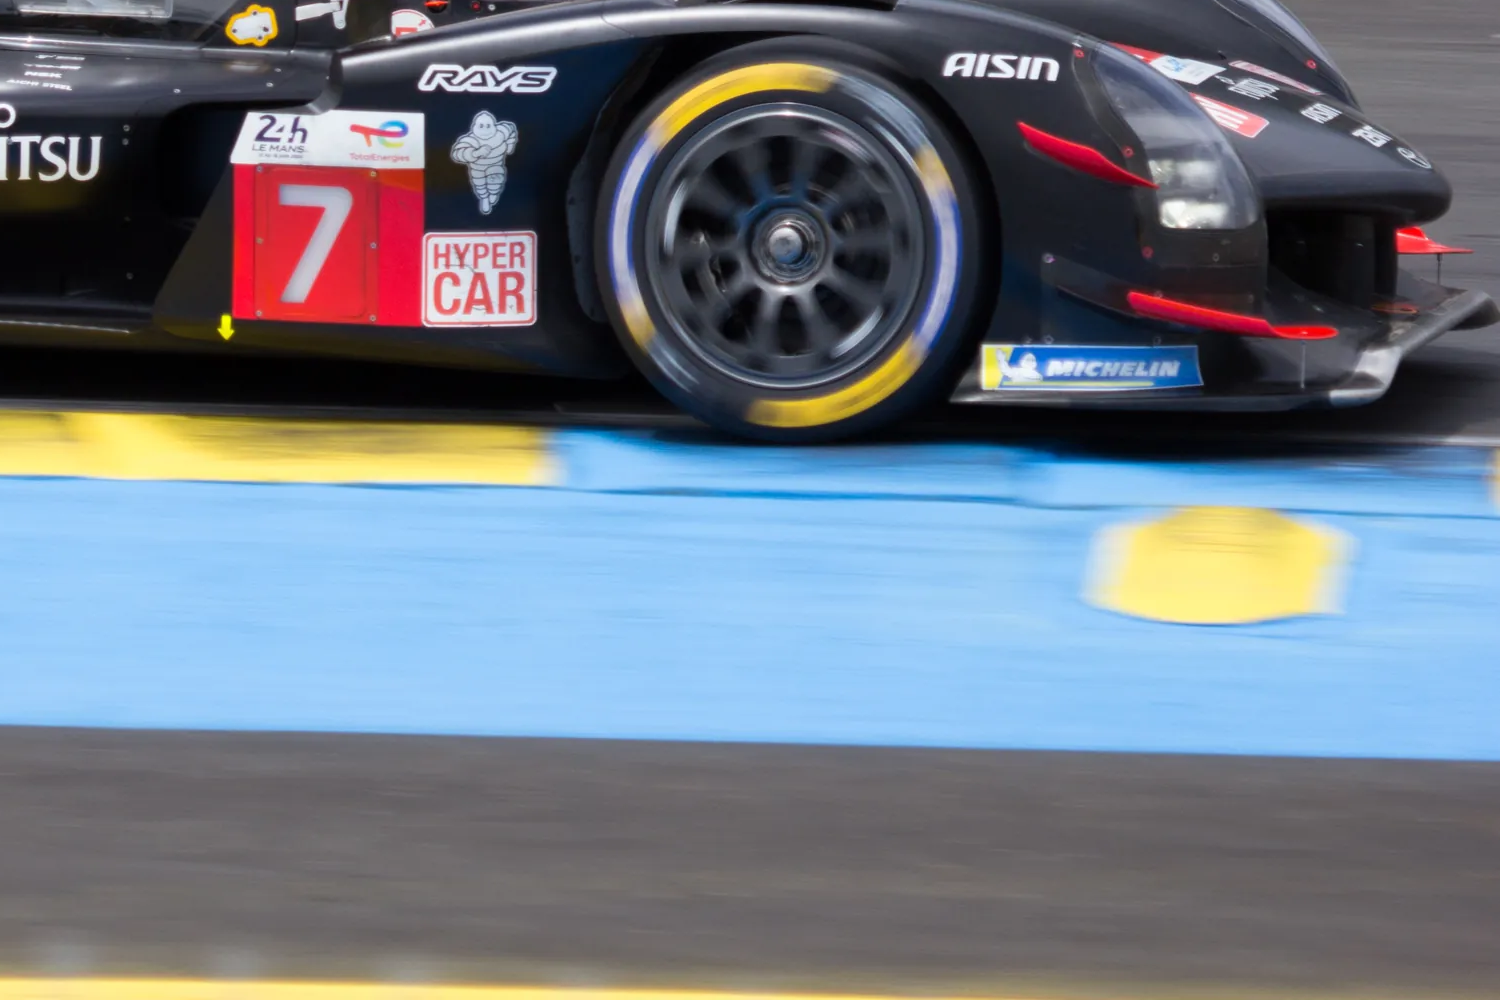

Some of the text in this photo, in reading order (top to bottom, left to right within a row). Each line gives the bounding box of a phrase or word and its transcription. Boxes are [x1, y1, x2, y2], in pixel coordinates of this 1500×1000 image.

[420, 65, 556, 91] RAYS
[943, 53, 1060, 82] AISIN
[252, 143, 304, 153] LE MANS
[350, 152, 410, 163] TotalEnergies
[278, 183, 353, 303] 7
[433, 241, 526, 270] HYPER
[433, 271, 526, 316] CAR
[1045, 360, 1181, 378] MICHELIN
